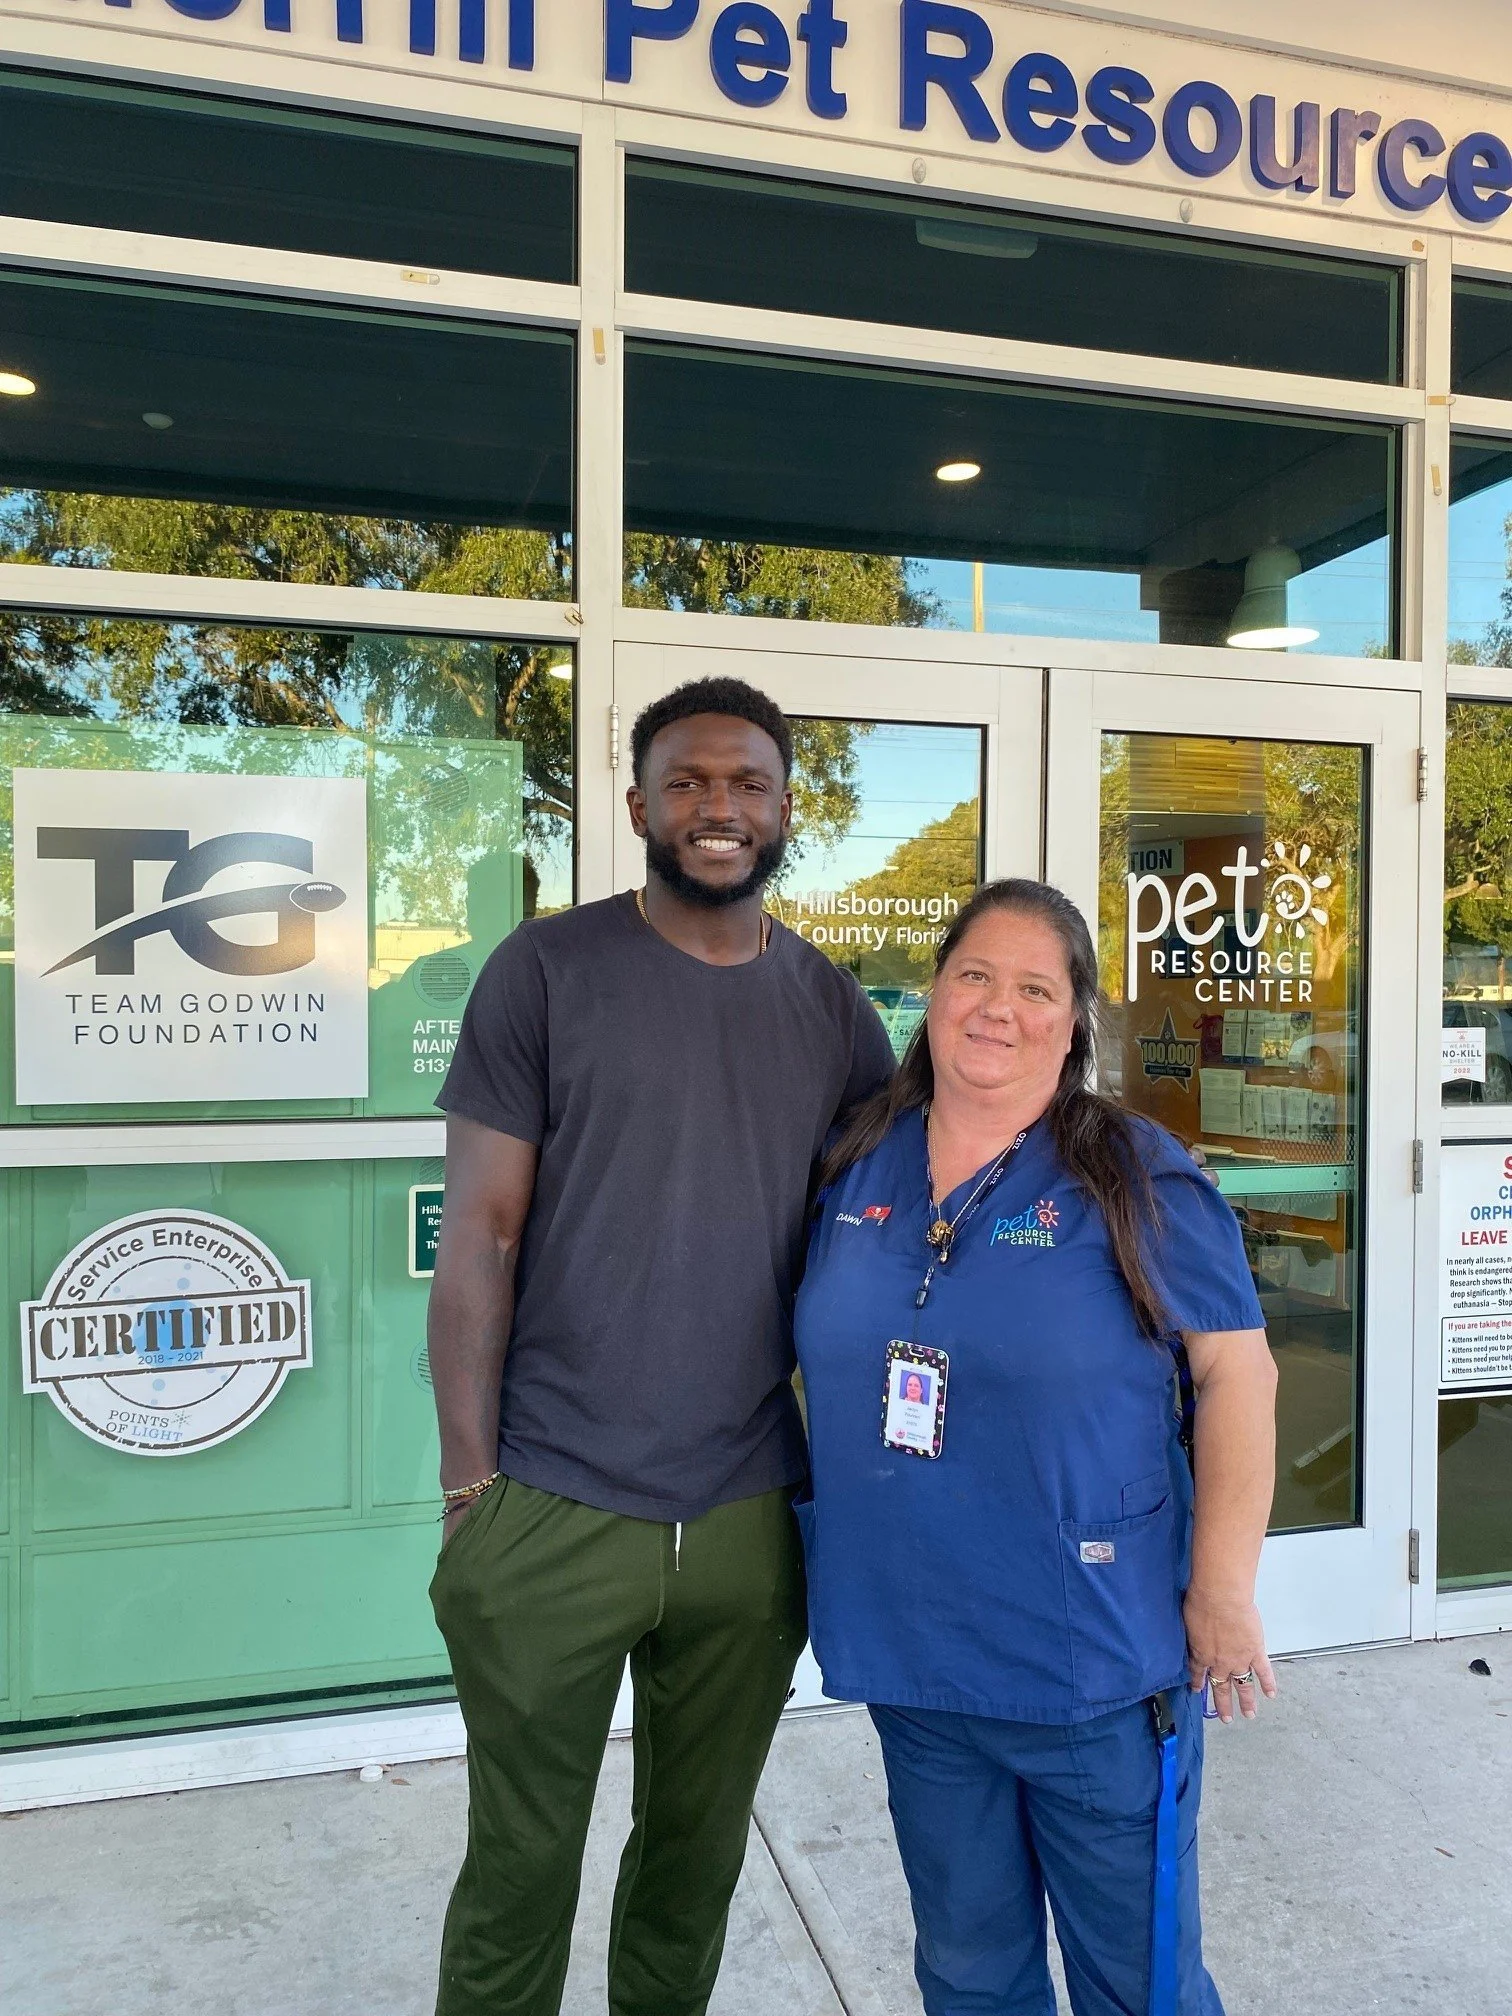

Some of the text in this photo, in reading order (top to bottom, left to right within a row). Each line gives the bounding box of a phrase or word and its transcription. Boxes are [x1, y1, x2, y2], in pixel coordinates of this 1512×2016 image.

[605, 0, 848, 120] Pet
[900, 0, 1512, 223] Resource
[794, 891, 959, 923] Hillsborough
[1128, 846, 1269, 1002] pet
[795, 920, 889, 951] County
[1151, 950, 1313, 975] RESOURCE
[1195, 979, 1313, 1003] CENTER
[66, 993, 326, 1014] TEAM GODWIN
[74, 1023, 318, 1045] FOUNDATION
[1442, 1049, 1482, 1058] NO-KILL
[836, 1212, 863, 1226] DAWN
[990, 1204, 1037, 1246] pet
[998, 1229, 1053, 1240] RESOURCE
[1011, 1237, 1056, 1247] CENTER
[1461, 1230, 1508, 1246] LEAVE
[68, 1229, 262, 1301] Service Enterprise
[1454, 1256, 1474, 1266] nearly
[1475, 1256, 1484, 1264] all
[1484, 1256, 1506, 1264] cases,
[1449, 1268, 1467, 1276] think
[1468, 1268, 1474, 1276] is
[1449, 1279, 1481, 1287] Research
[1482, 1278, 1502, 1286] shows
[1450, 1290, 1465, 1299] drop
[1453, 1300, 1490, 1308] euthanasia
[40, 1300, 297, 1361] CERTIFIED
[1448, 1322, 1454, 1330] If
[1455, 1323, 1466, 1331] you
[1479, 1320, 1501, 1329] taking
[1452, 1346, 1473, 1354] Kittens
[1474, 1344, 1488, 1352] need
[138, 1355, 165, 1365] 2018
[178, 1352, 205, 1362] 2021
[109, 1409, 170, 1428] POINTS
[106, 1422, 183, 1442] OF LIGHT
